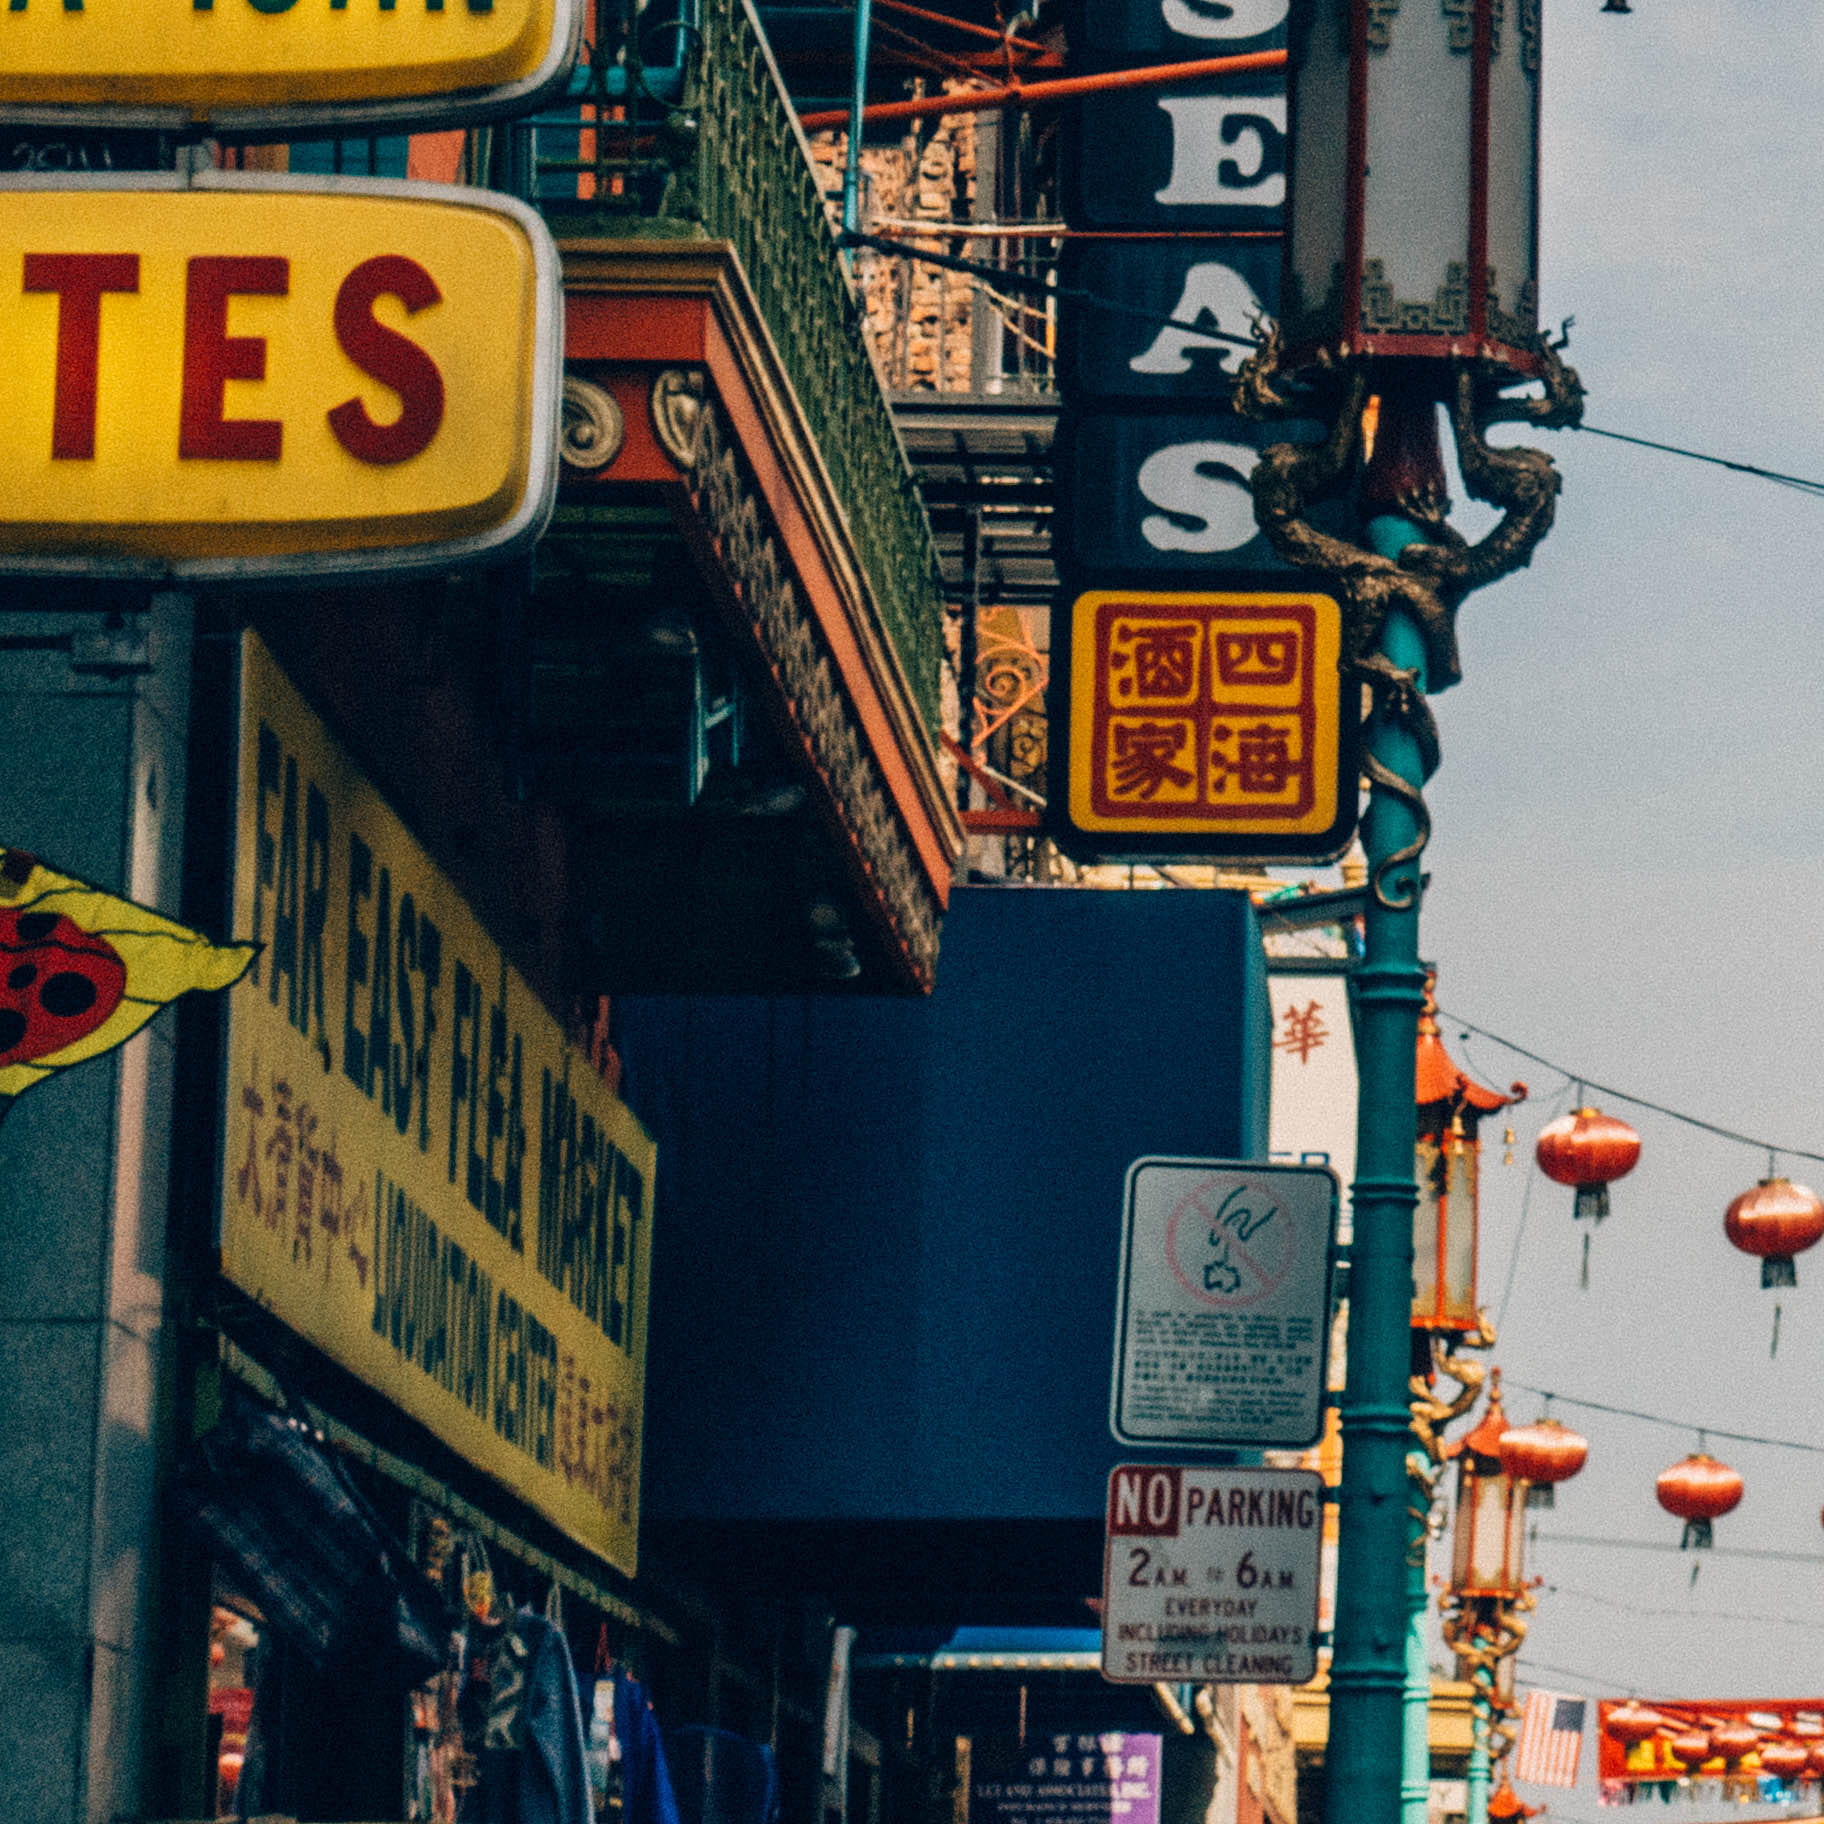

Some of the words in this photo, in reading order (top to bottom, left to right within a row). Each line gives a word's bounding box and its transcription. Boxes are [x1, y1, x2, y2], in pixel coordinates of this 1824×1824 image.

[23, 253, 446, 466] TES
[253, 719, 331, 1054] FAR
[343, 831, 441, 1153] EAST
[449, 959, 524, 1252] FLEA
[537, 1065, 643, 1359] MARKET
[1116, 1473, 1172, 1525] NO
[1186, 1487, 1314, 1529] PARKING
[1164, 1597, 1258, 1617] EVERYDAY
[1117, 1622, 1211, 1642] INCLUDING
[1125, 1651, 1193, 1673] STREET
[1202, 1654, 1294, 1676] CLEANING
